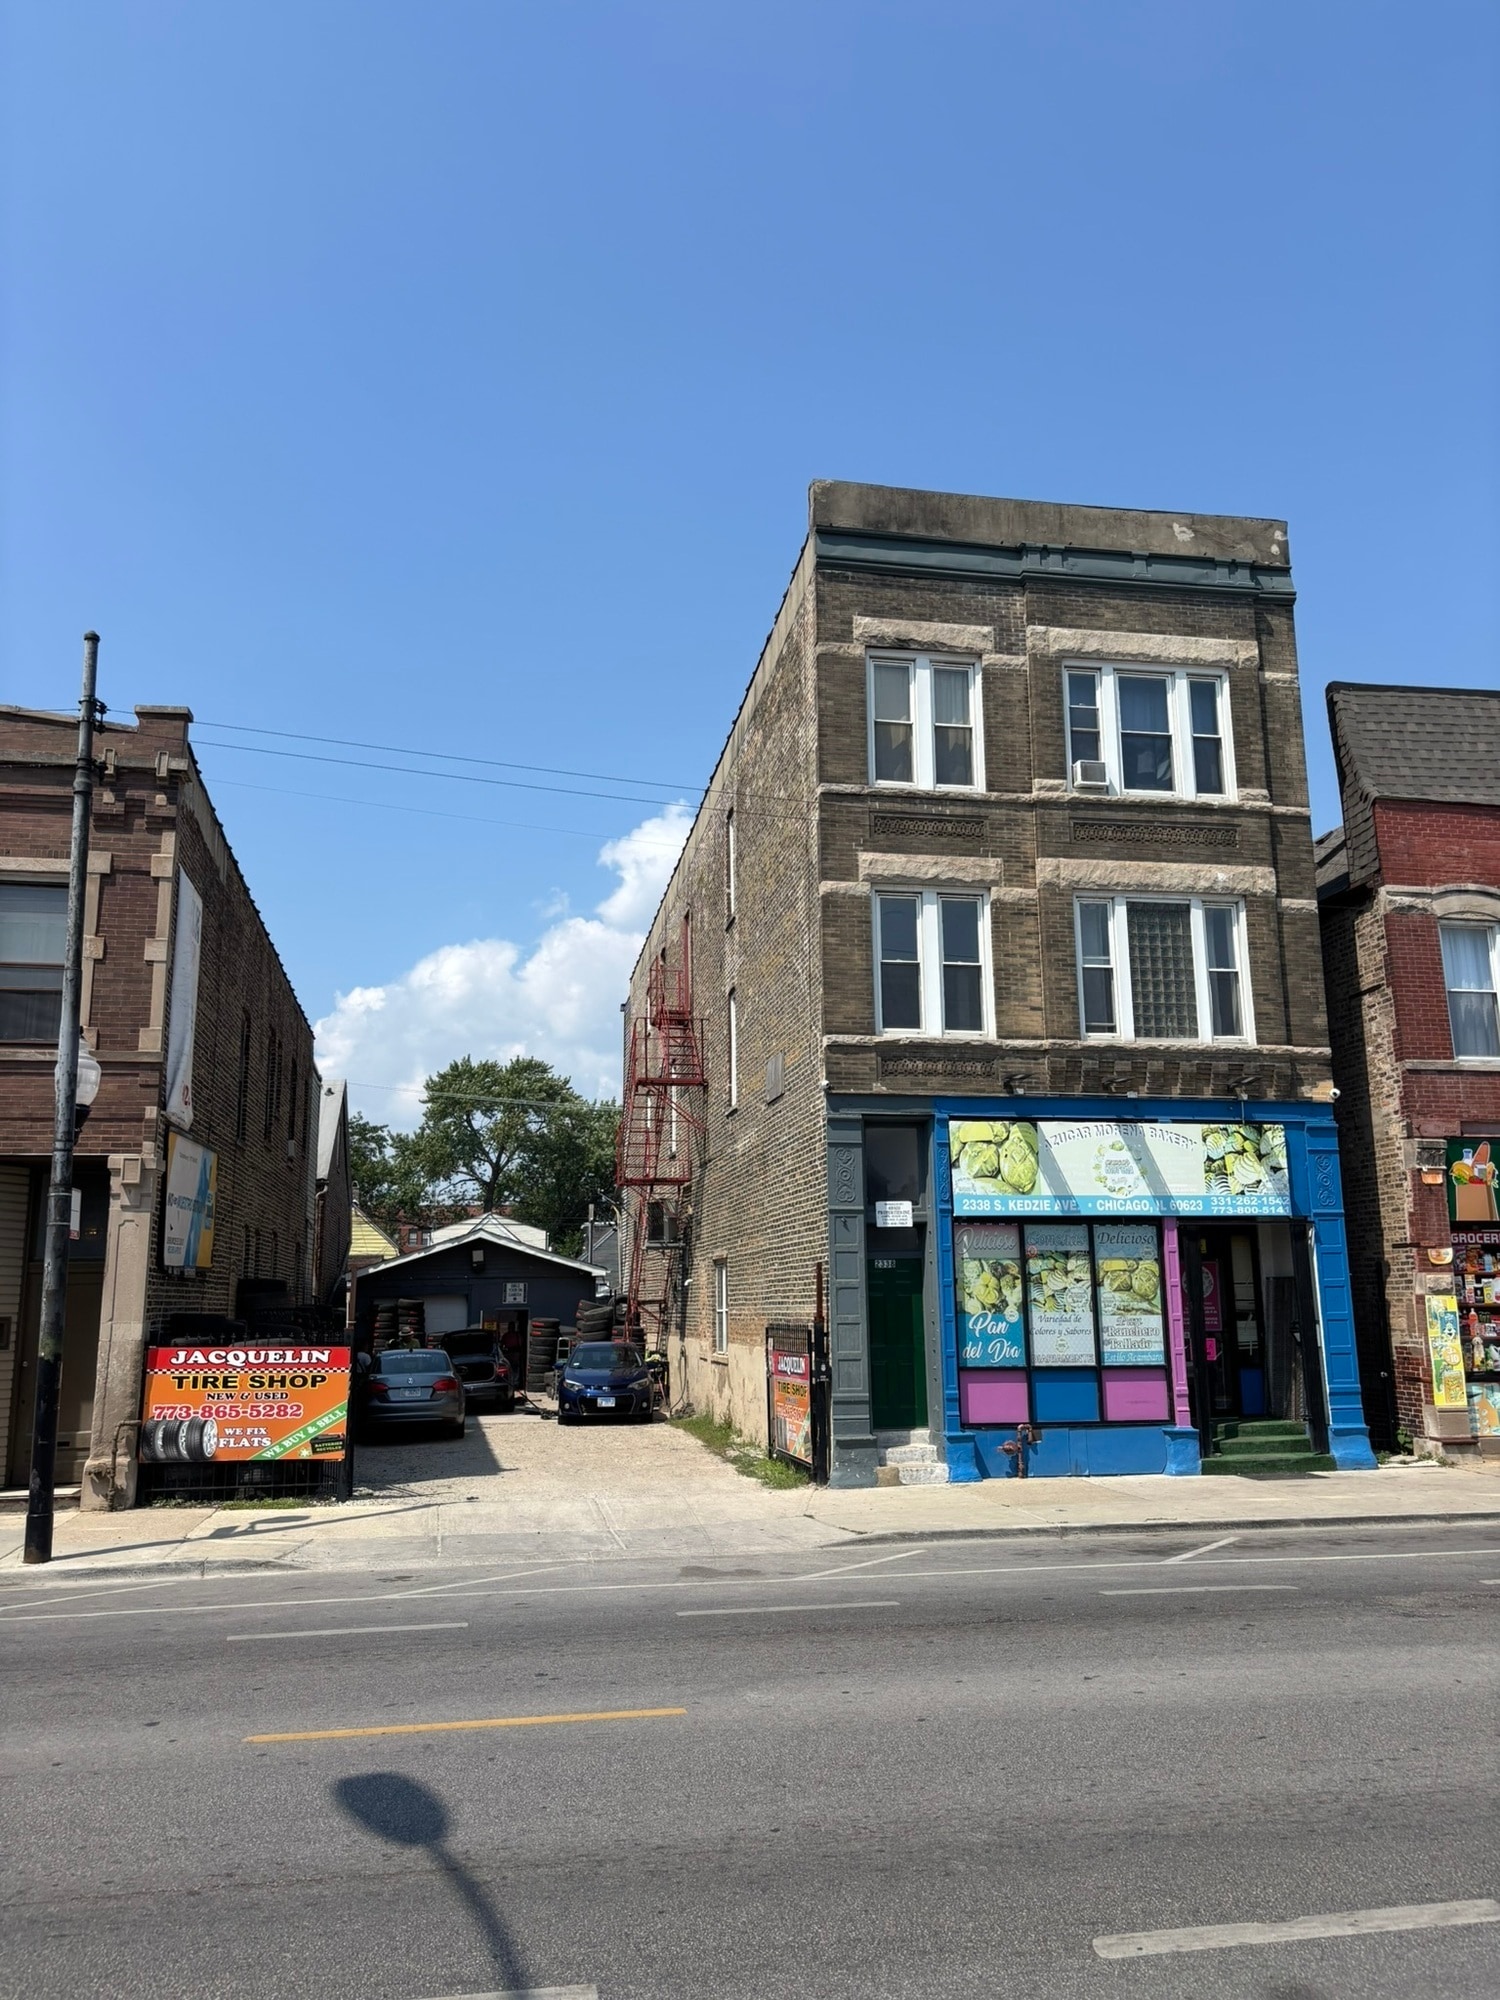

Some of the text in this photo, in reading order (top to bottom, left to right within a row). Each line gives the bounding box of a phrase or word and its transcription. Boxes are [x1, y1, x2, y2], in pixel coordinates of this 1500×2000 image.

[1043, 1123, 1198, 1152] AZUCAR MORENA BAKERY
[962, 1199, 1203, 1213] 2338 S. KEDZIE AVE. CHICAGO, IL 60623
[1211, 1196, 1290, 1206] 331-262-1542
[1211, 1206, 1291, 1214] 773-800-5141
[956, 1227, 1017, 1254] Delicioso
[1097, 1231, 1155, 1245] Delicioso
[1450, 1232, 1500, 1244] GROCER
[969, 1311, 1010, 1338] Pan
[1038, 1314, 1083, 1323] Variedad de
[1029, 1327, 1093, 1338] Colores y Sabores
[962, 1342, 984, 1359] del
[1109, 1338, 1153, 1350] Tallado
[169, 1349, 332, 1367] JACQUELIN
[171, 1374, 328, 1391] TIRE SHOP
[777, 1381, 791, 1396] TIRE
[206, 1392, 289, 1401] NEW & USED
[153, 1403, 304, 1421] 773-865-5282
[224, 1426, 267, 1436] WE FIX
[261, 1407, 347, 1461] WE BUY & SELL
[218, 1437, 272, 1448] FLATS
